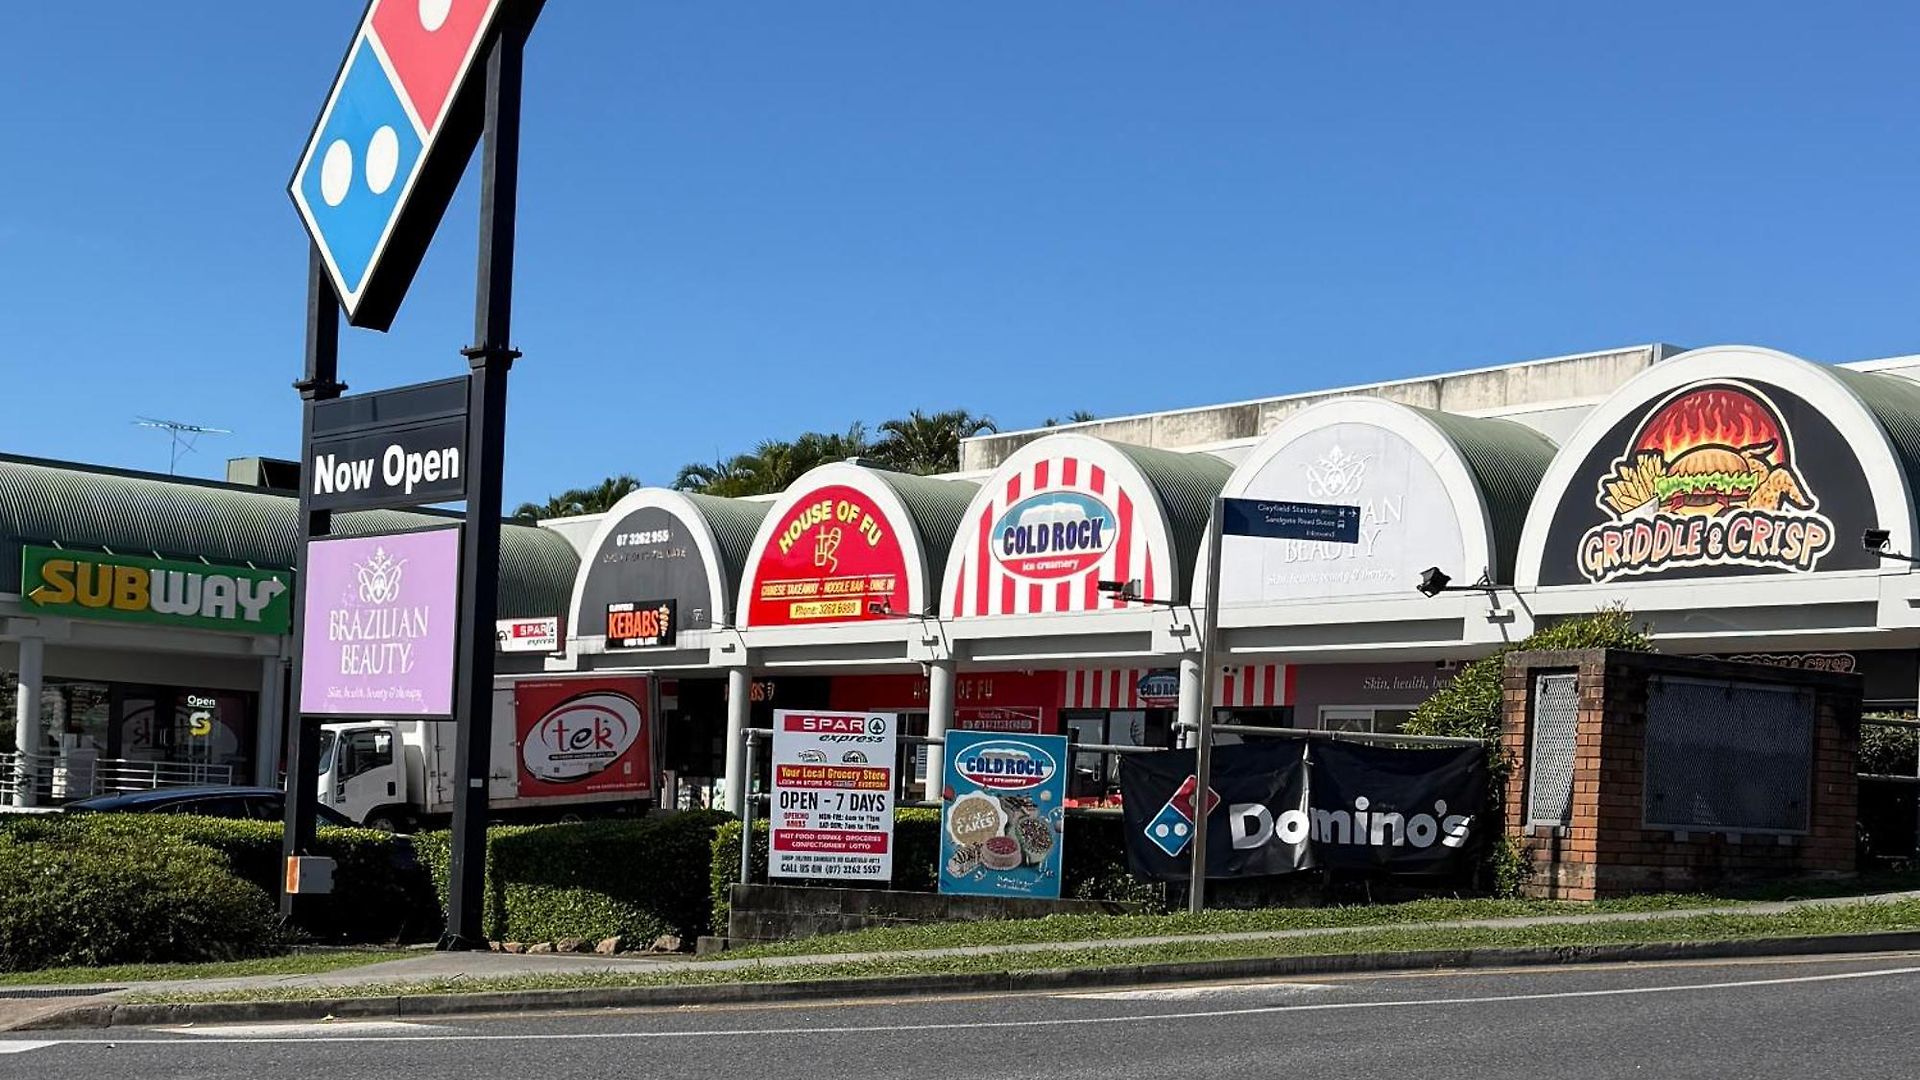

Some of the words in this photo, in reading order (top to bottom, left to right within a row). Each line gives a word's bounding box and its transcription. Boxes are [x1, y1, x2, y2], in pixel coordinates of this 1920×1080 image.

[314, 454, 375, 495] Now
[382, 444, 460, 495] Open
[778, 500, 833, 555] HOUSE
[836, 500, 861, 524] OF
[859, 513, 883, 546] FU
[1003, 523, 1050, 556] COLD
[1051, 517, 1104, 551] ROCK
[616, 534, 627, 547] 07
[1584, 519, 1703, 576] GRIDDLE
[1707, 525, 1723, 555] &
[1727, 516, 1827, 566] CRISP
[1022, 561, 1036, 571] ice
[1037, 558, 1080, 571] creamery
[29, 559, 288, 622] SUBWAY
[761, 583, 786, 597] CHINESE
[787, 582, 819, 595] TAKEAWAY
[329, 606, 430, 642] BRAZILIAN
[519, 624, 548, 637] SPAR
[608, 610, 659, 639] KEBABS
[340, 643, 414, 675] BEAUTY
[1140, 683, 1162, 698] COLD
[1162, 683, 1180, 698] ROC
[1363, 676, 1390, 691] Skin,
[1393, 675, 1429, 691] health,
[187, 694, 215, 708] Open
[552, 716, 614, 753] tek
[803, 717, 864, 732] SPAR
[818, 734, 886, 743] express
[781, 766, 801, 778] Your
[803, 767, 826, 779] Local
[827, 768, 861, 781] Grocery
[863, 768, 886, 780] Store
[966, 756, 1003, 774] COLD
[1005, 757, 1044, 776] ROCK
[780, 791, 819, 810] OPEN
[835, 792, 845, 811] 7
[849, 793, 885, 812] DAYS
[1229, 796, 1473, 850] Domino's
[780, 864, 798, 873] CALL
[799, 864, 810, 873] US
[810, 865, 823, 874] ON
[825, 865, 841, 874] (07)
[862, 866, 881, 874] 5557
